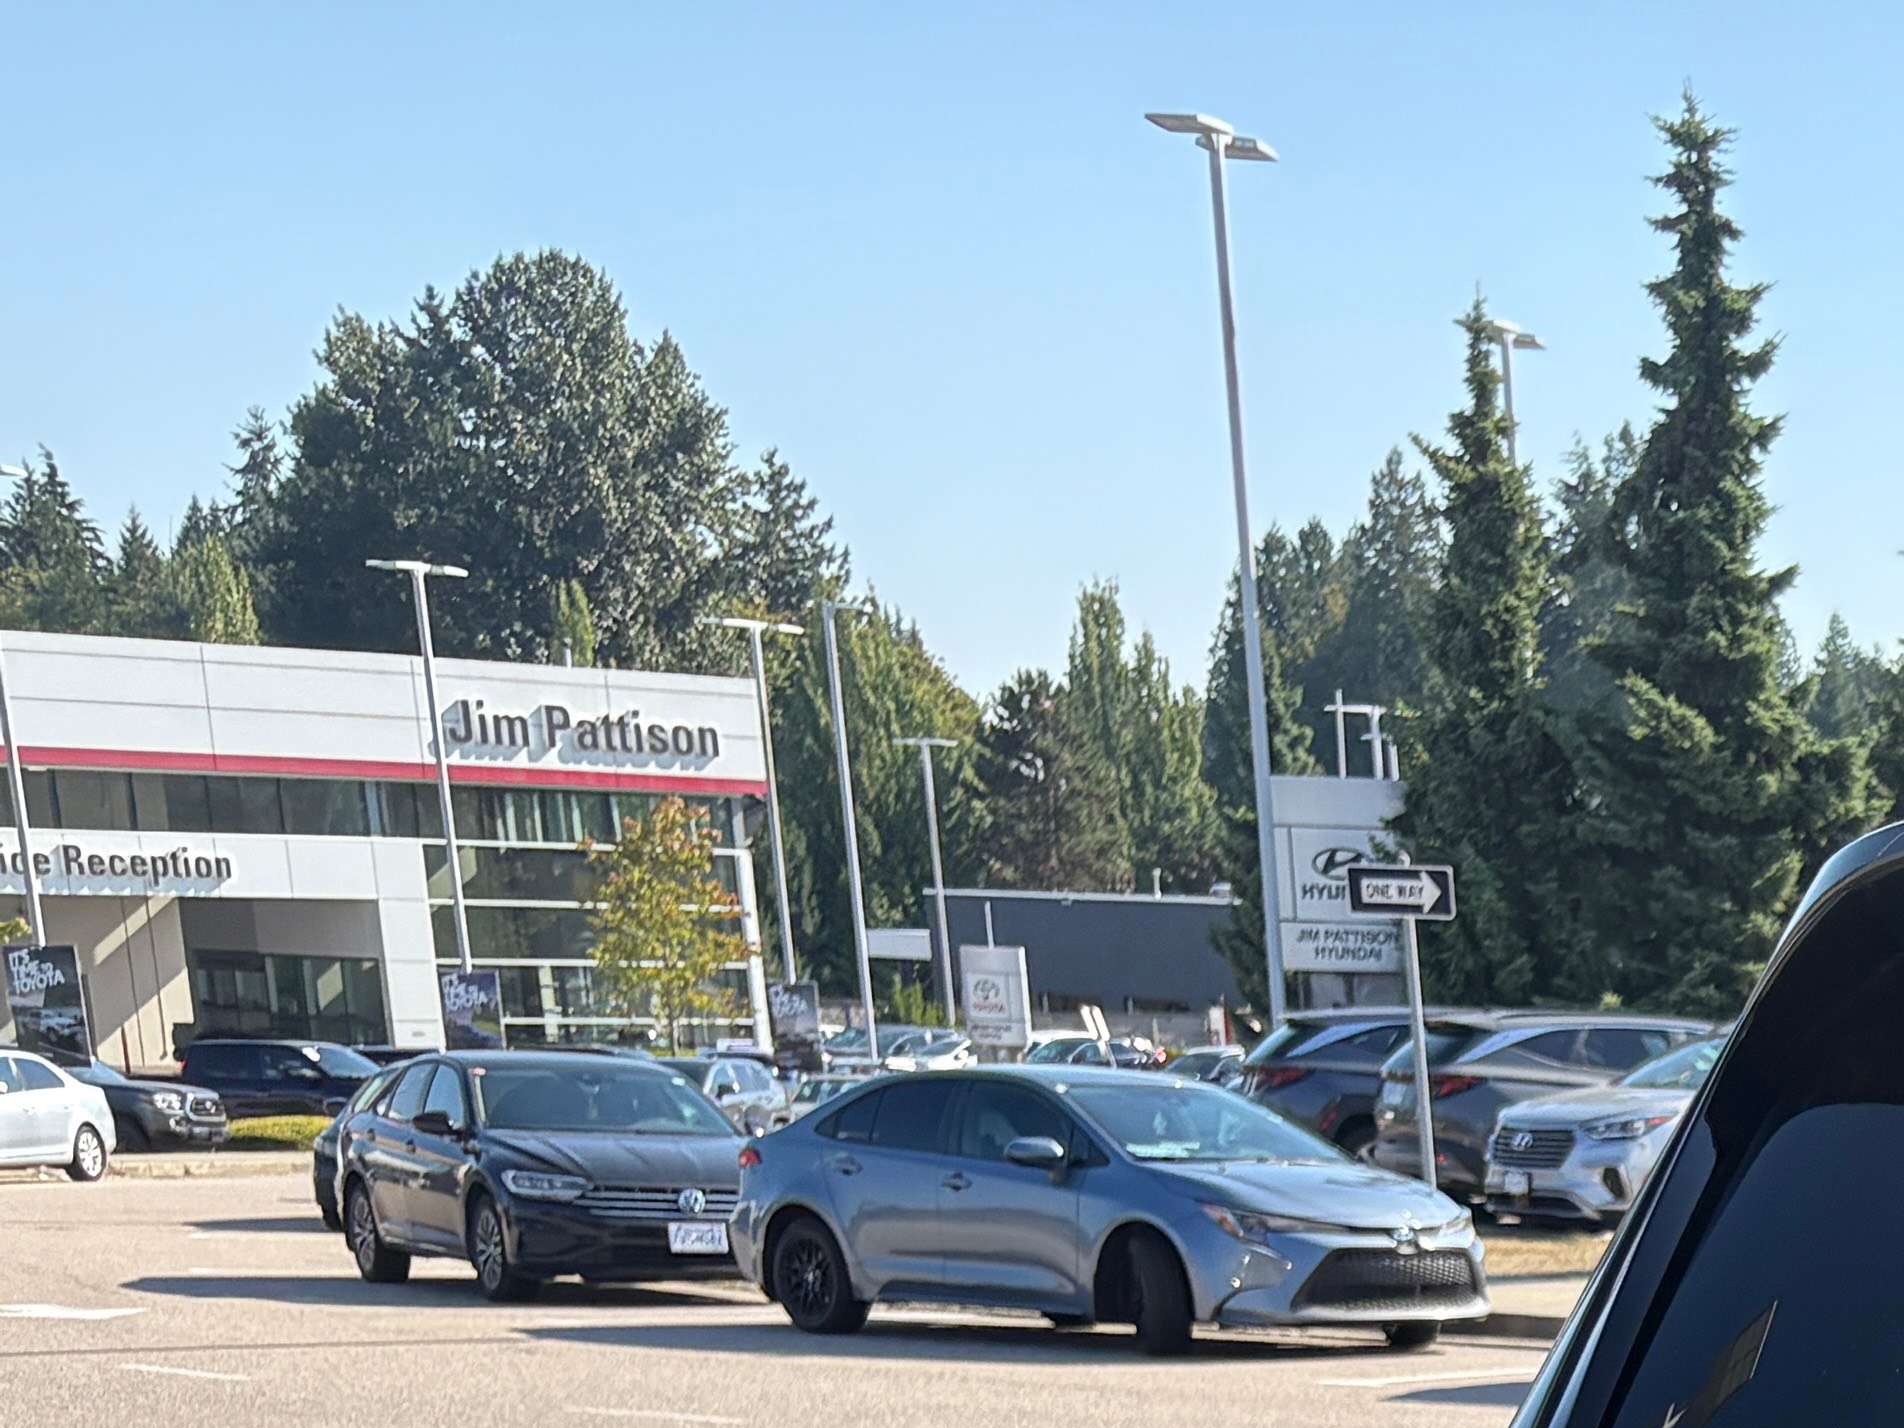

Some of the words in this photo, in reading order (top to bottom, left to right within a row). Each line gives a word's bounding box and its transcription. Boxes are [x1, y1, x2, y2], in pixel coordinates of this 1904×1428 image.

[449, 698, 530, 748] Jim
[542, 704, 720, 758] Pattison
[62, 844, 232, 888] Reception
[1366, 883, 1393, 899] ONE
[1397, 883, 1425, 899] WAY
[1296, 928, 1320, 943] JIM
[1323, 928, 1400, 946] PATTISON
[1314, 944, 1383, 961] HYUNDAI
[13, 969, 66, 994] TOYOTA
